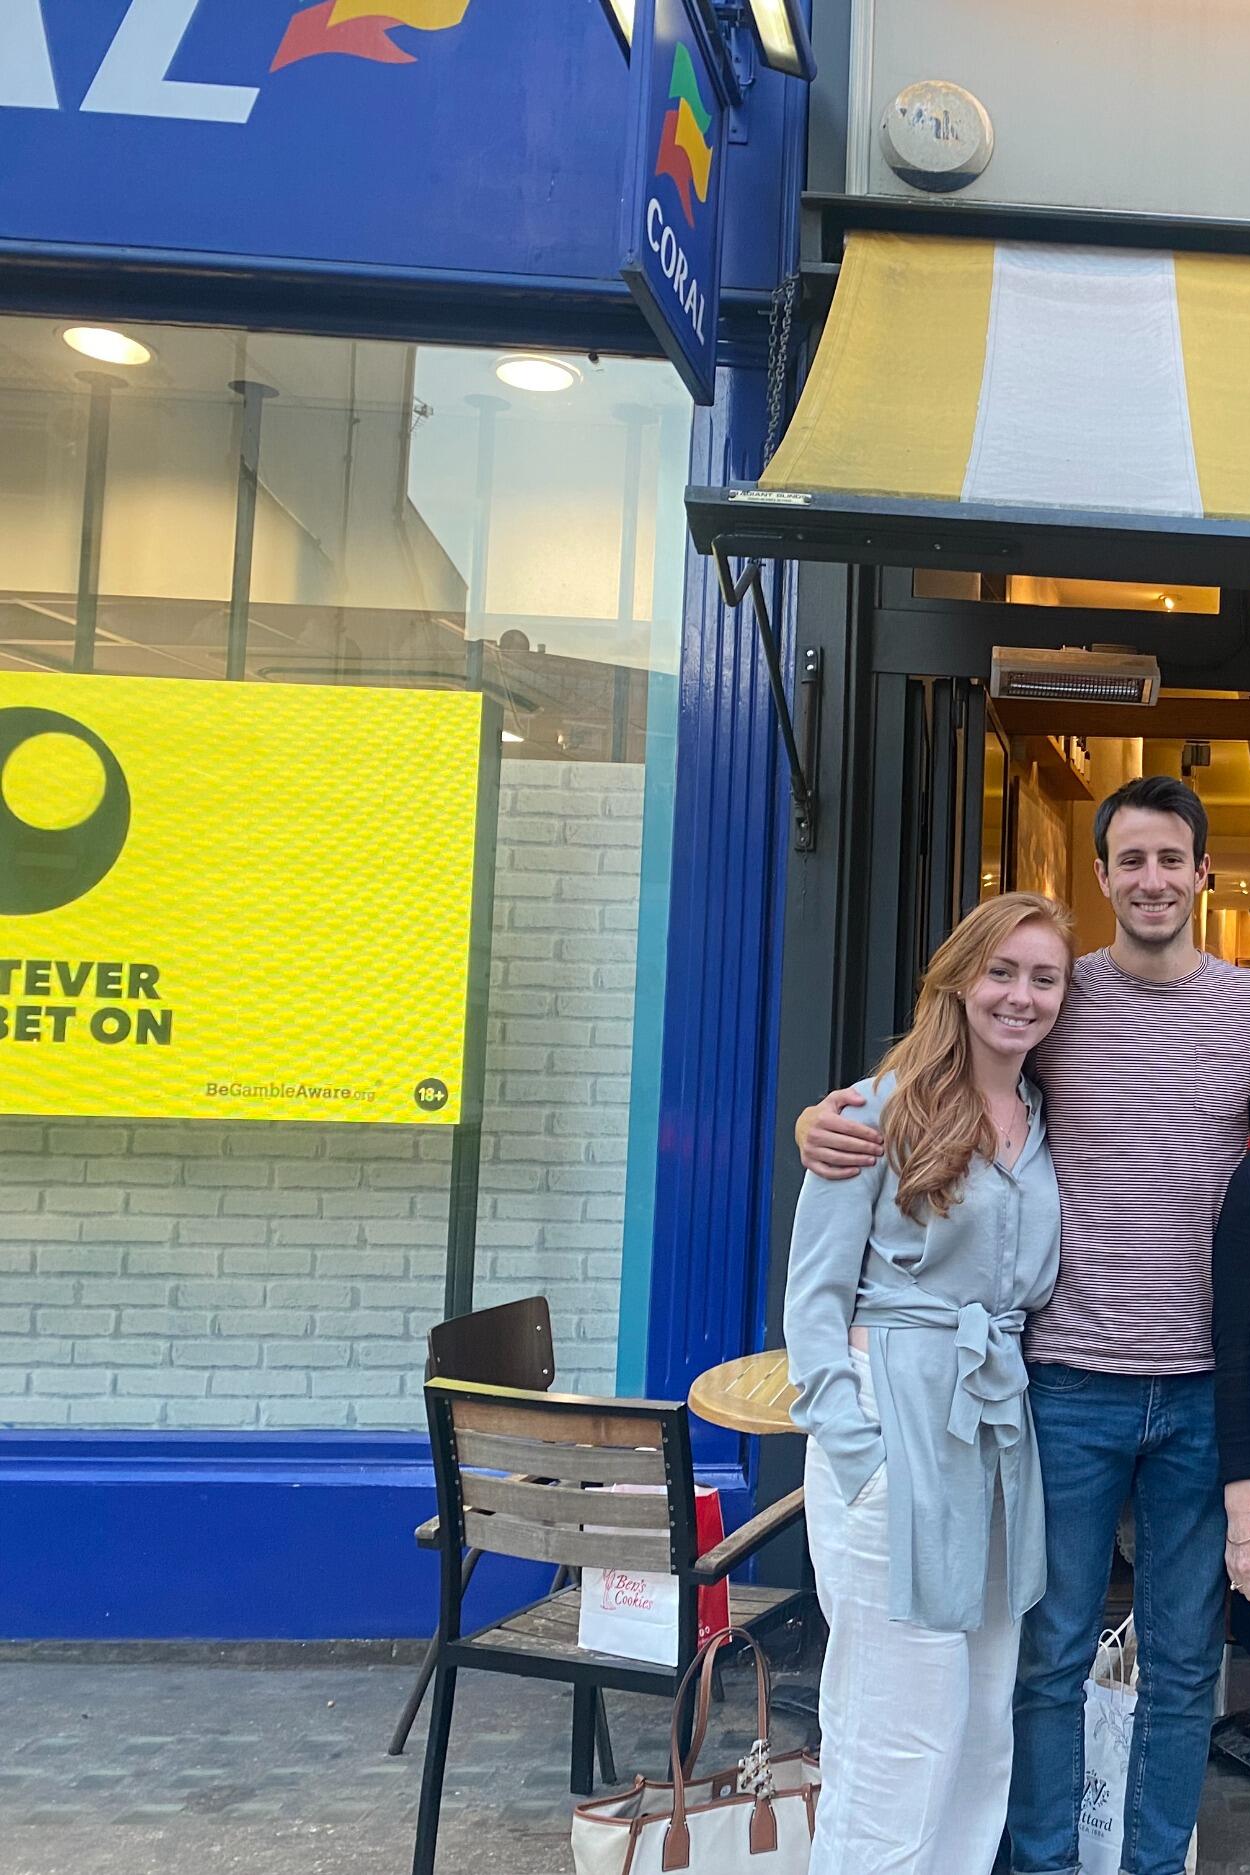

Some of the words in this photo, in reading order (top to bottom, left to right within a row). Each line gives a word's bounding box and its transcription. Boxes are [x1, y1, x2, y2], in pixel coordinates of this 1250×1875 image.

[647, 197, 705, 346] CORAL
[0, 959, 161, 1000] TEVER
[90, 1007, 173, 1045] ON
[206, 1082, 376, 1102] BeGambleAware.org
[418, 1087, 445, 1102] 18+
[615, 1574, 647, 1593] Ben's
[615, 1590, 654, 1610] Cookies
